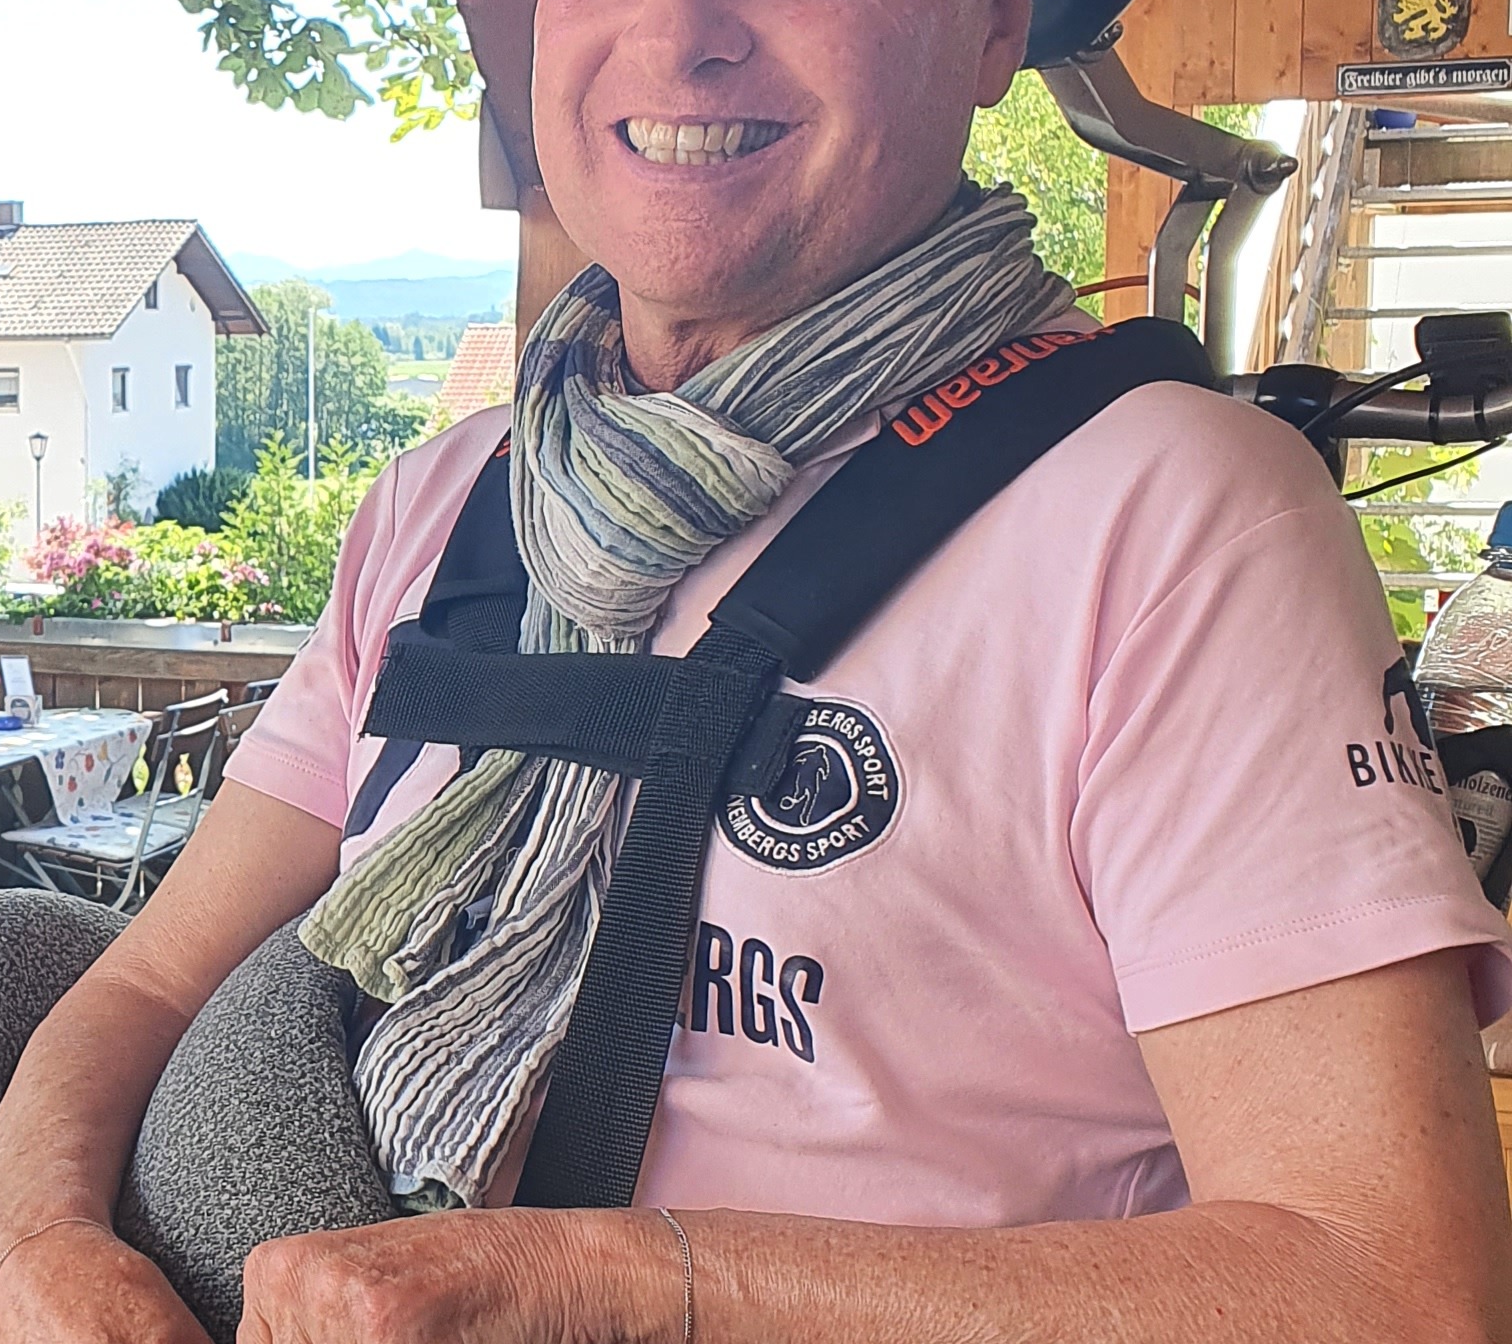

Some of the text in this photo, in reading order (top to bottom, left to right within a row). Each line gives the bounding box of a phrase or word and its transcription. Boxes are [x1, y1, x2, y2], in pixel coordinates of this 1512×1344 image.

[1344, 70, 1403, 91] Freibier
[1452, 68, 1509, 86] morgen
[853, 735, 889, 801] SPORT
[806, 814, 870, 860] SPORT
[678, 920, 824, 1064] RGS
